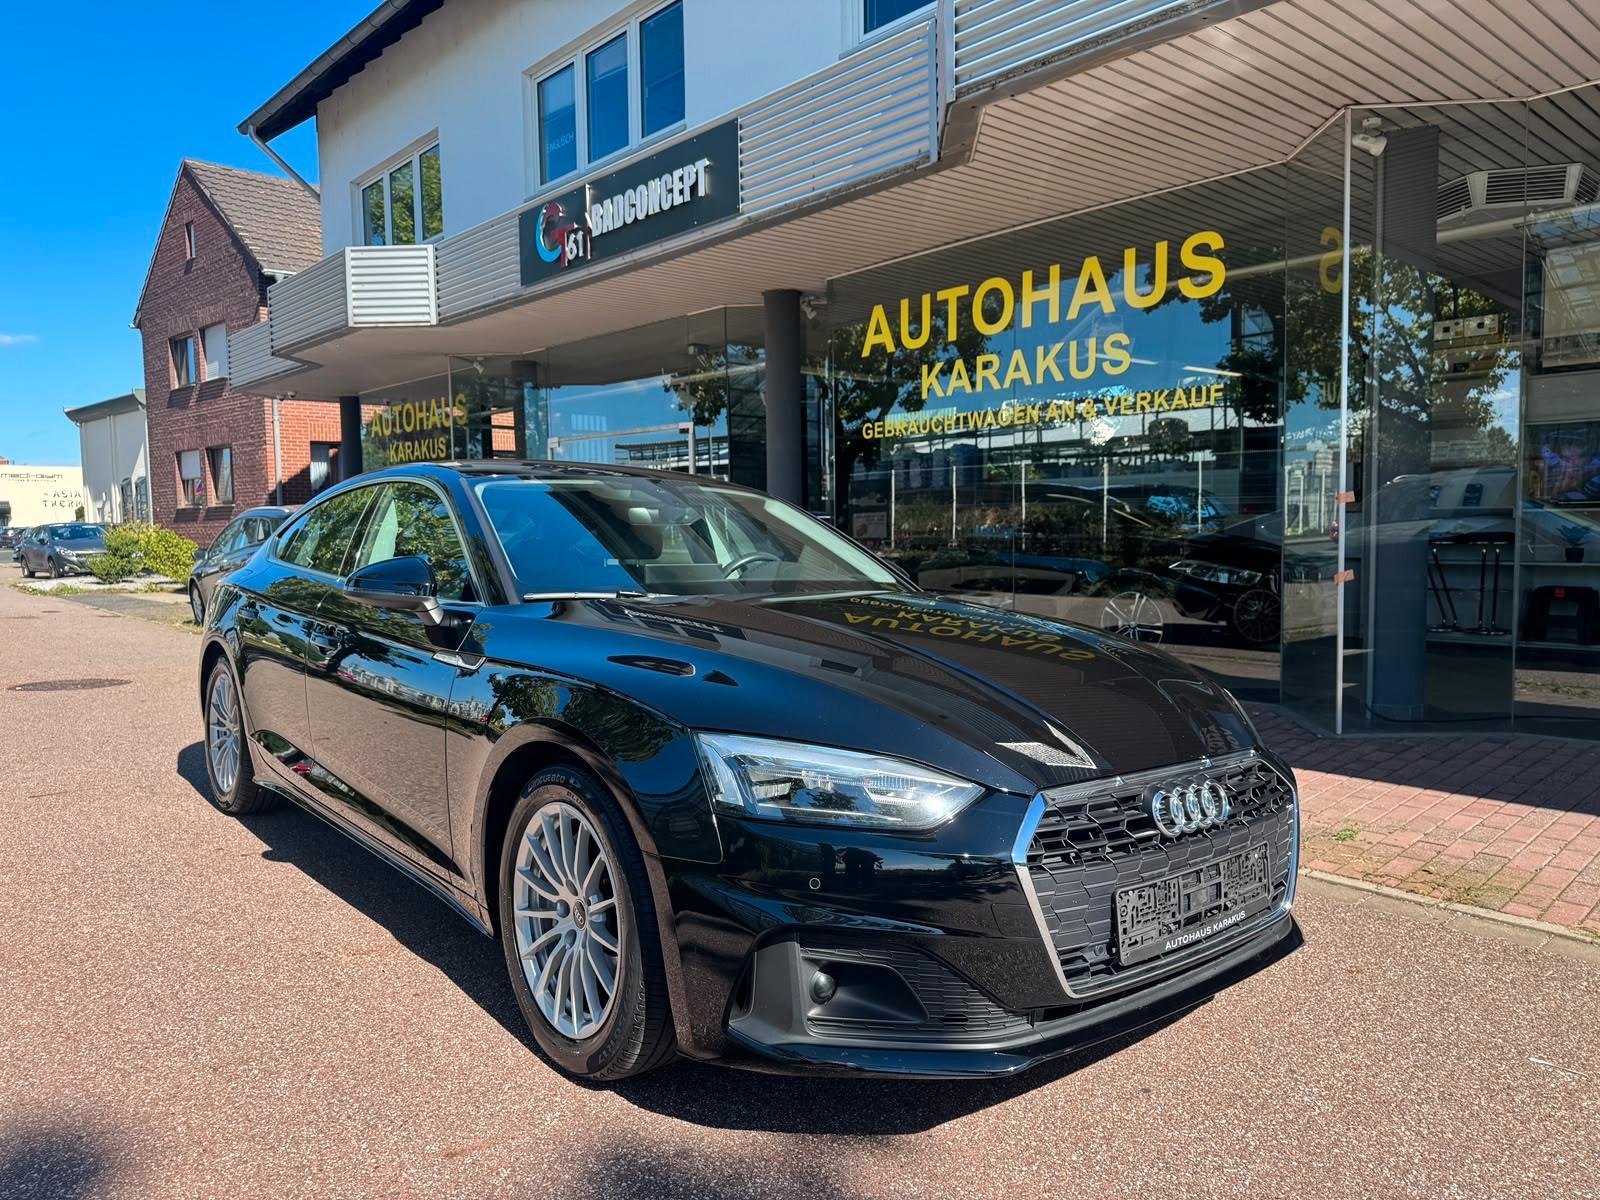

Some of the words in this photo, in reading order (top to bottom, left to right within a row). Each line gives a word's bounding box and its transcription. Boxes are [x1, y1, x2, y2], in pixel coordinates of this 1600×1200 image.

[591, 158, 711, 238] BADCONCEPT
[861, 231, 1226, 358] AUTOHAUS
[921, 332, 1131, 399] KARAKUS
[371, 393, 469, 437] AUTOHAUS
[861, 404, 1041, 439] GEBRAUCHTWAGEN
[1046, 399, 1076, 420] AN
[1083, 397, 1097, 418] &
[1103, 384, 1225, 417] VERKAUF
[389, 436, 446, 463] KARAKUS
[53, 489, 82, 498] ASIA
[1165, 926, 1211, 950] AUTOHAUS
[1213, 910, 1246, 931] KARAKUS
